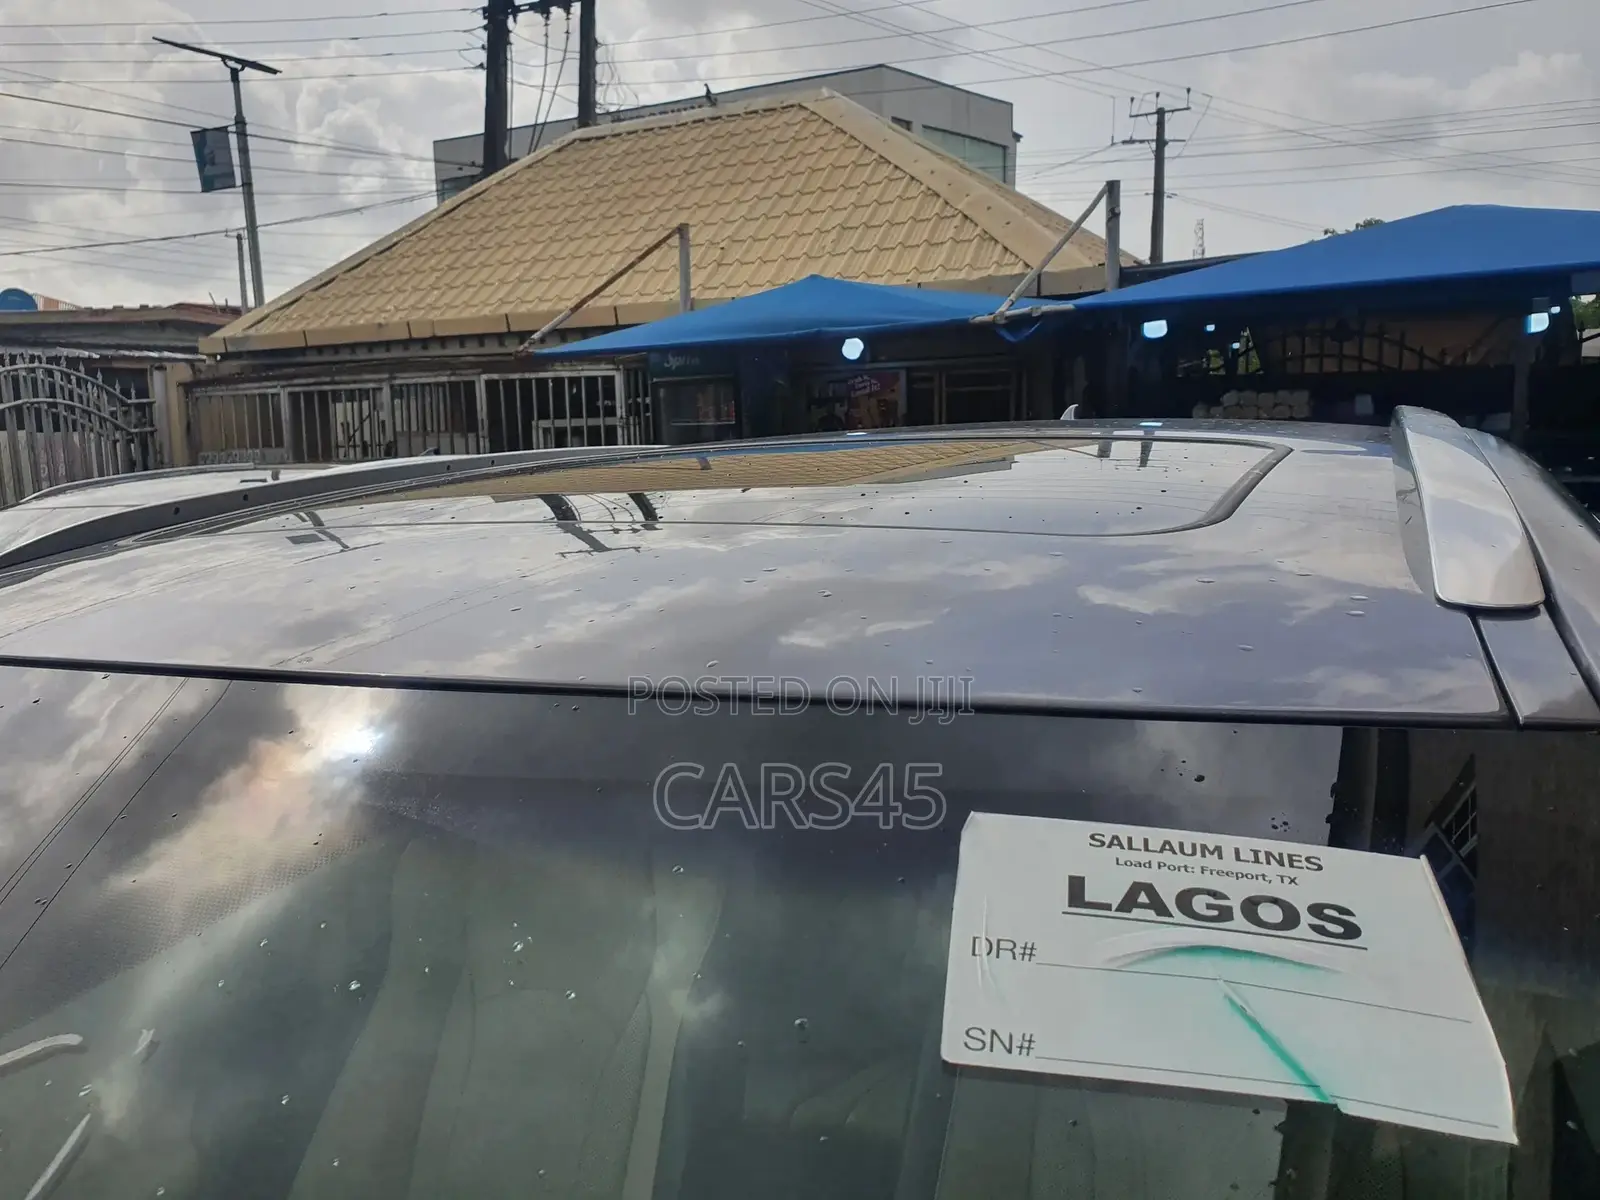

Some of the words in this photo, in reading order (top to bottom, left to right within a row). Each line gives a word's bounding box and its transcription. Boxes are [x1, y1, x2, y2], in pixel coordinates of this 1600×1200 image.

[1088, 832, 1224, 861] SALLAUM
[1233, 846, 1324, 873] LINES
[1115, 856, 1153, 871] Load
[1157, 860, 1196, 875] Port:
[1200, 864, 1273, 885] Freeport,
[1276, 873, 1300, 887] TX
[1067, 874, 1364, 942] LAGOS
[971, 935, 1037, 964] DR#
[962, 1027, 1037, 1057] SN#
